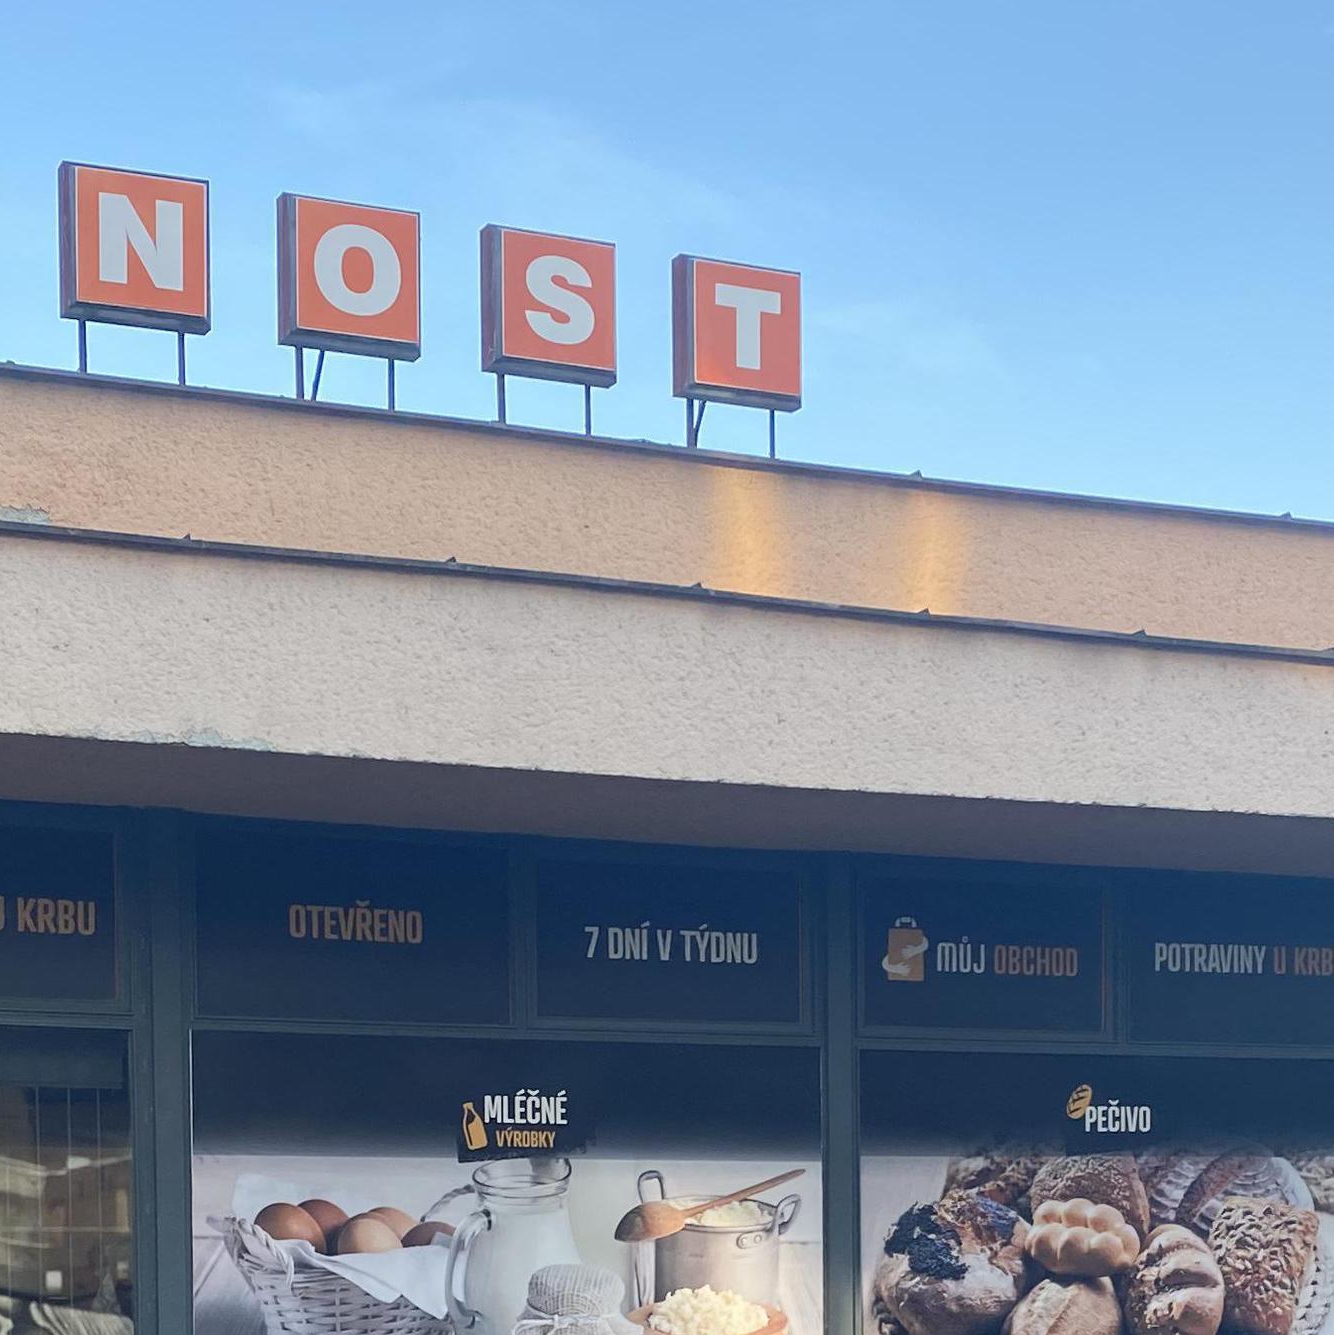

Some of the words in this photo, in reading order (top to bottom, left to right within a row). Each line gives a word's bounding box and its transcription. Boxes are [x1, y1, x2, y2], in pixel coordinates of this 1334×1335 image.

[17, 899, 97, 936] KRBU
[289, 901, 423, 944] OTEVŘENO
[584, 926, 598, 958] 7
[608, 921, 648, 961] DNÍ
[658, 930, 673, 961] V
[681, 924, 758, 964] TÝDNU
[936, 936, 985, 975] MŮJ
[994, 946, 1078, 977] OBCHOD
[1155, 943, 1267, 975] POTRAVINY
[1274, 946, 1286, 974] U
[484, 1089, 568, 1126] MLÉČNÉ
[1085, 1099, 1151, 1133] PEČIVO
[495, 1127, 556, 1149] VÝROBKY
